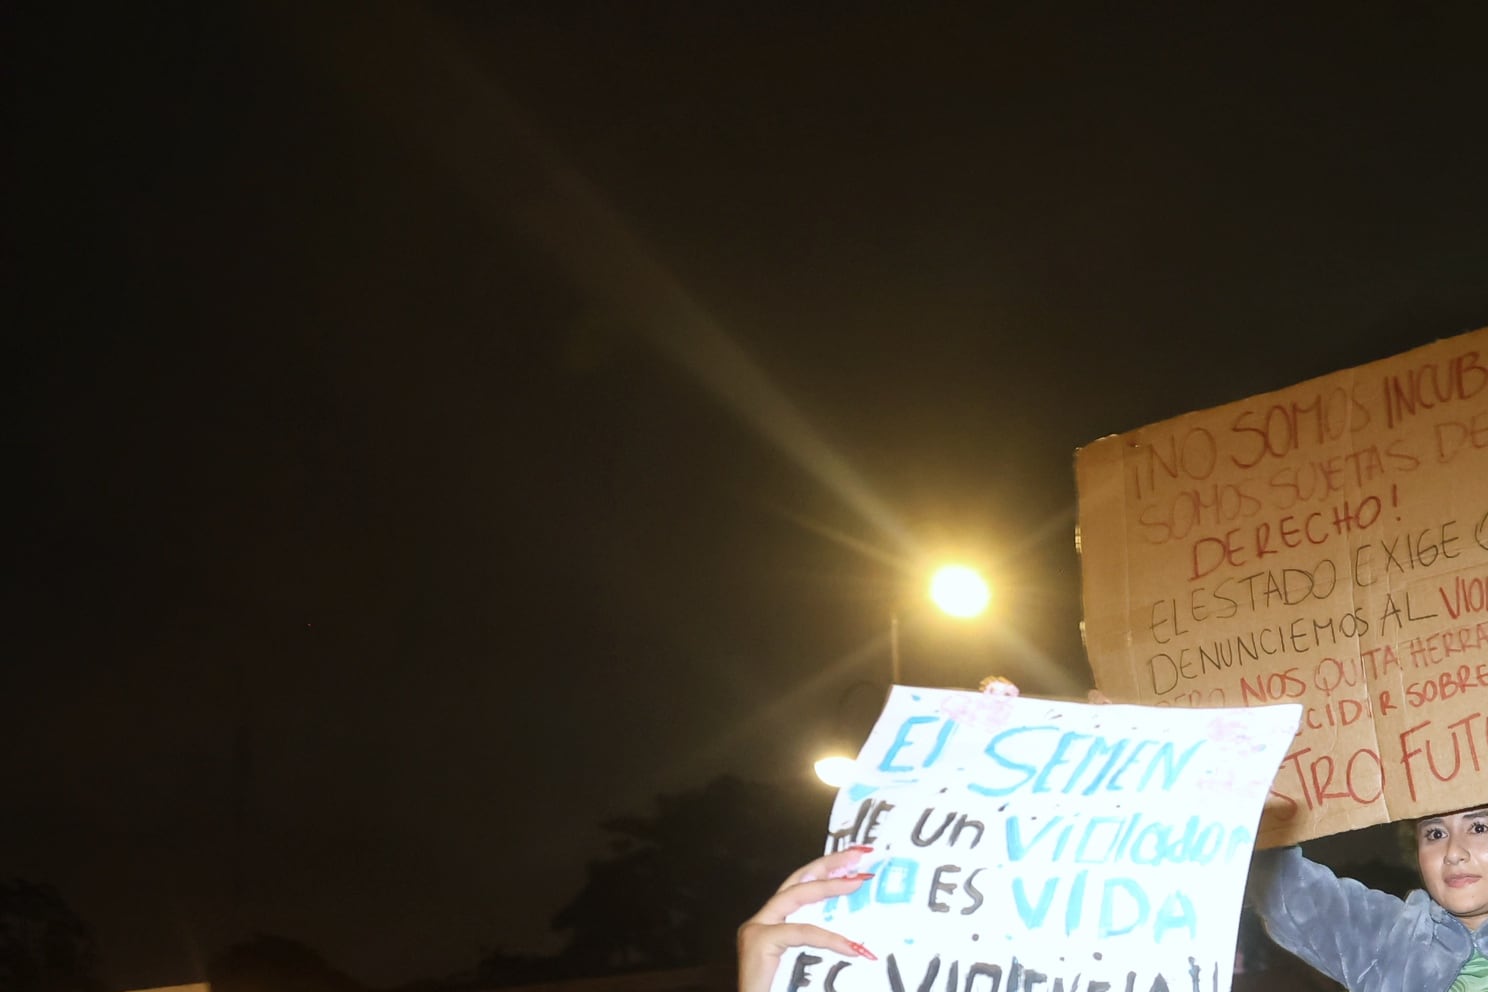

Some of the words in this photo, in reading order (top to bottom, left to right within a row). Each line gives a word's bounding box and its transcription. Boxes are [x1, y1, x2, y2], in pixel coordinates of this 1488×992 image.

[1134, 427, 1217, 499] ¡NO
[1231, 386, 1371, 469] SOMOS
[1139, 483, 1262, 545] SOMOS
[1269, 438, 1421, 502] SUJETAS
[1188, 484, 1402, 582] DERECHO!
[1191, 558, 1337, 621] ESTADO
[1355, 520, 1460, 588] EXIGE
[1147, 607, 1369, 695] DENUNCIEMOS
[1381, 591, 1438, 636] AL
[1240, 667, 1307, 708] NOS
[1314, 648, 1399, 696] QUITA
[967, 724, 1208, 797] SEMEN
[1295, 692, 1397, 737] CIDIR
[822, 856, 919, 913] NO
[928, 864, 987, 915] ES
[1011, 869, 1197, 944] VIDA
